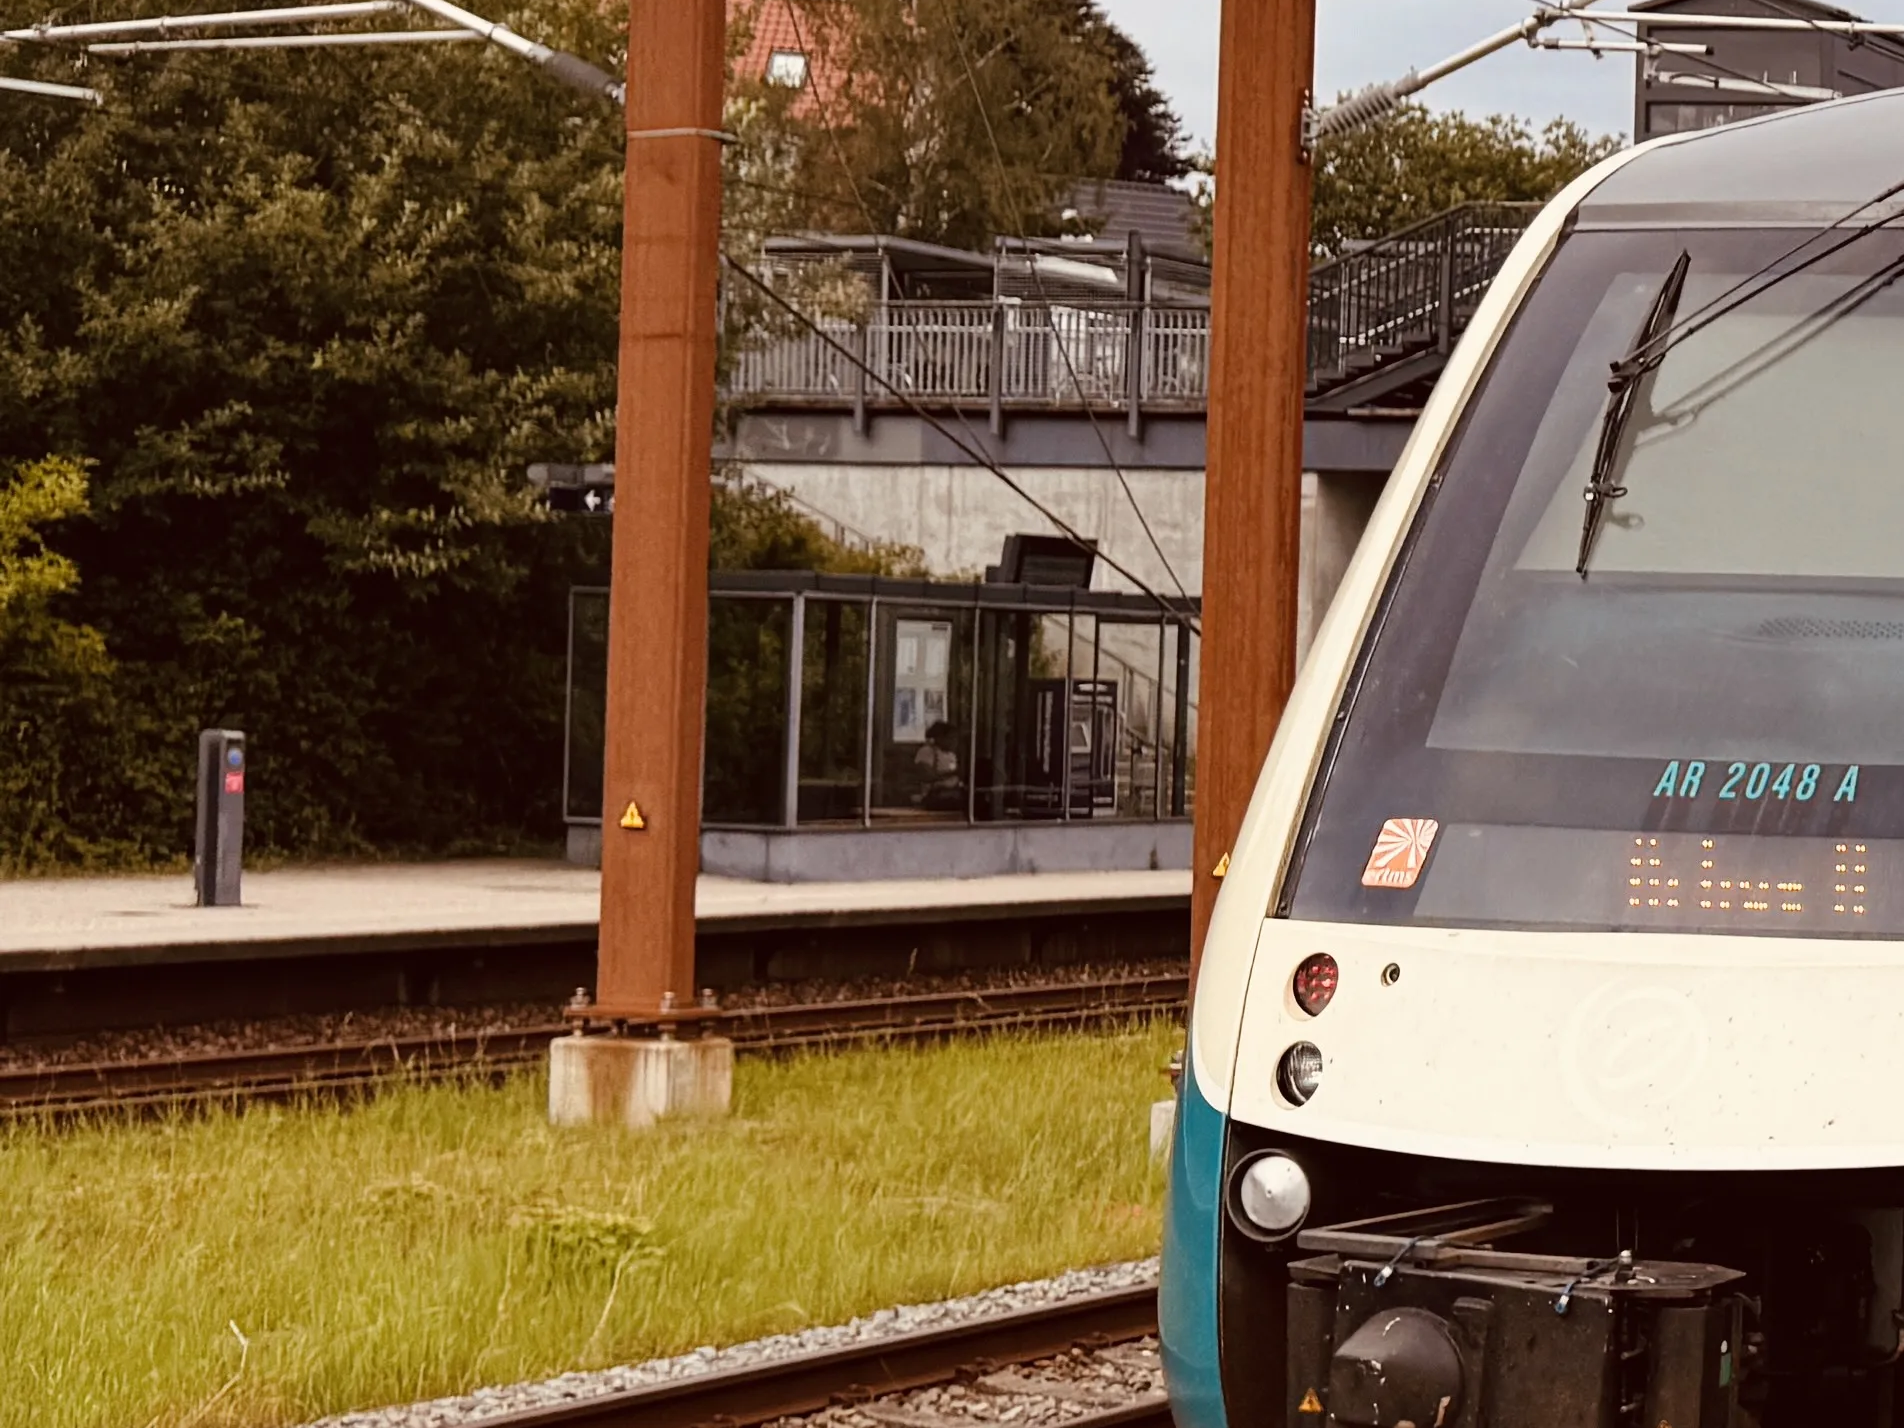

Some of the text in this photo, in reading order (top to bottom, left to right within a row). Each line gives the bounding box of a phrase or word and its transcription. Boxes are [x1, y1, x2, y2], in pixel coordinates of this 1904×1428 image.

[1653, 760, 1859, 802] AR 2048 A
